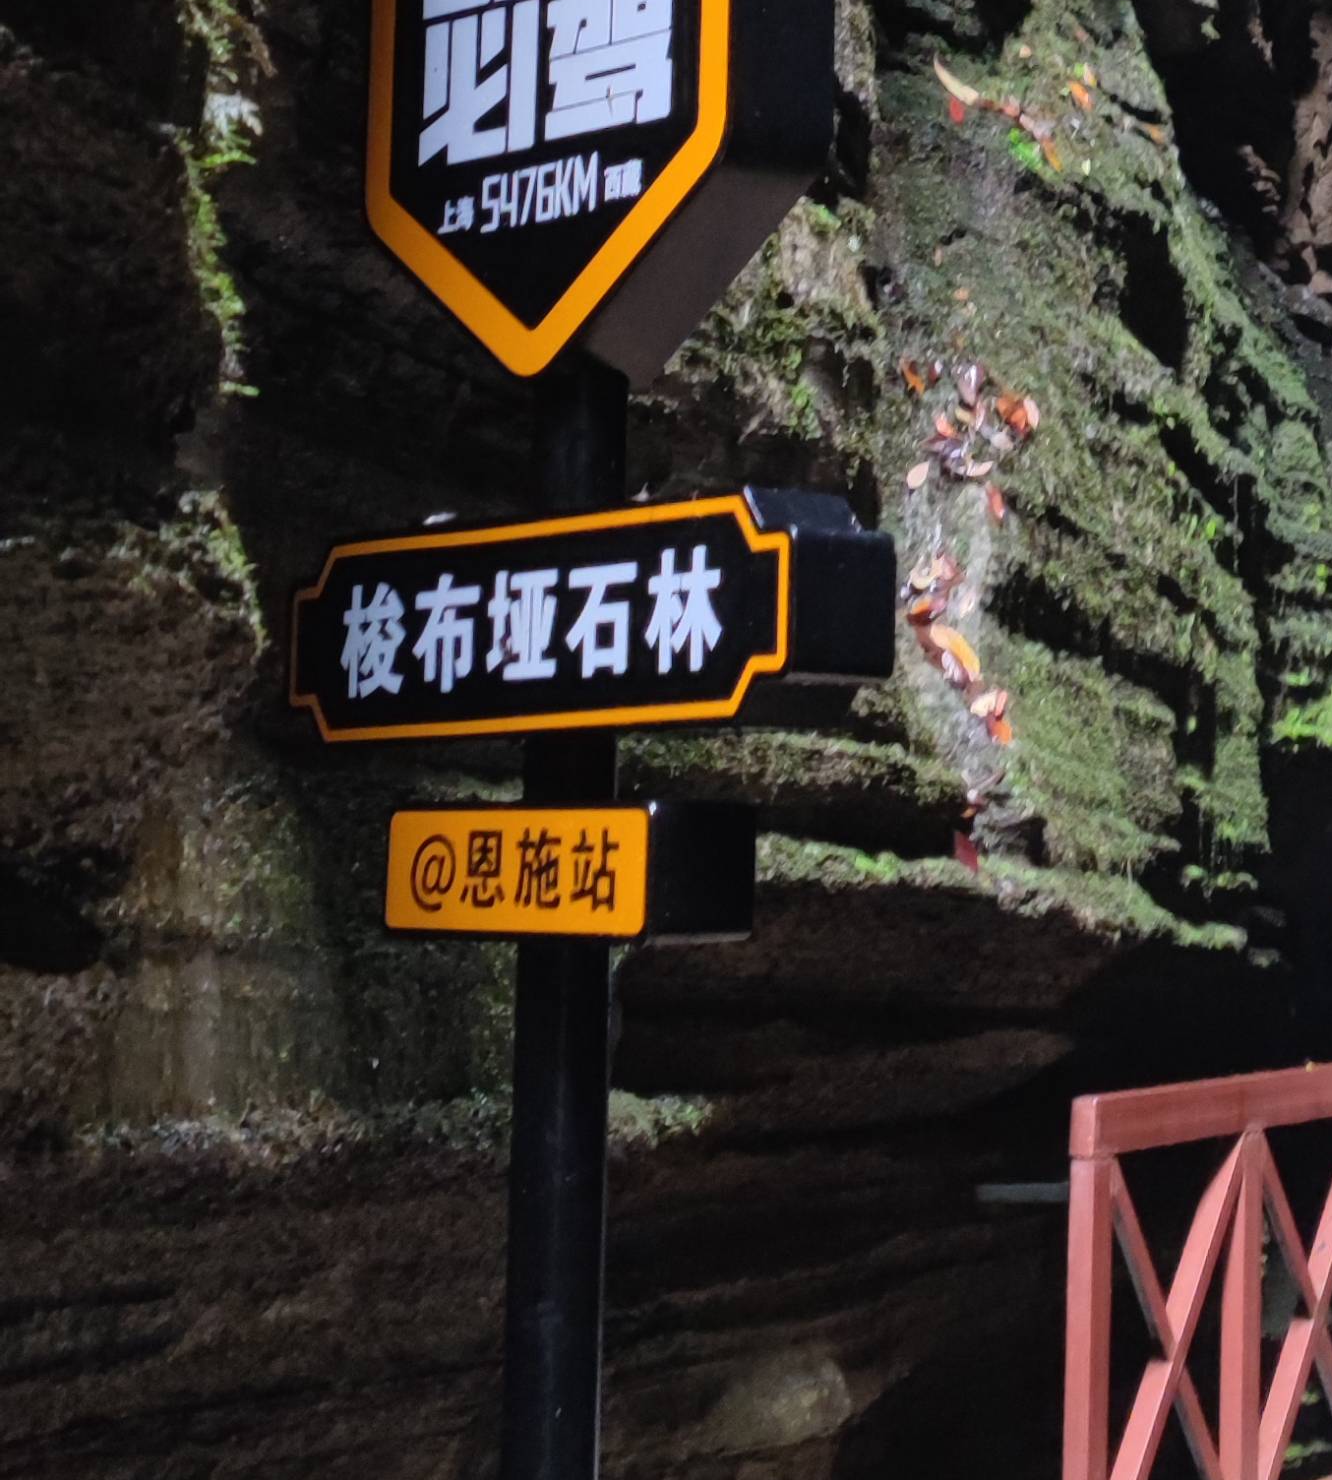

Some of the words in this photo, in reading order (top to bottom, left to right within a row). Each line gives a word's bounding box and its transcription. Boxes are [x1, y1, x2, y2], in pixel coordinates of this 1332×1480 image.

[480, 151, 599, 234] 5476KM
[341, 545, 722, 699] 梭布垭石林
[410, 826, 620, 913] @恩施站
